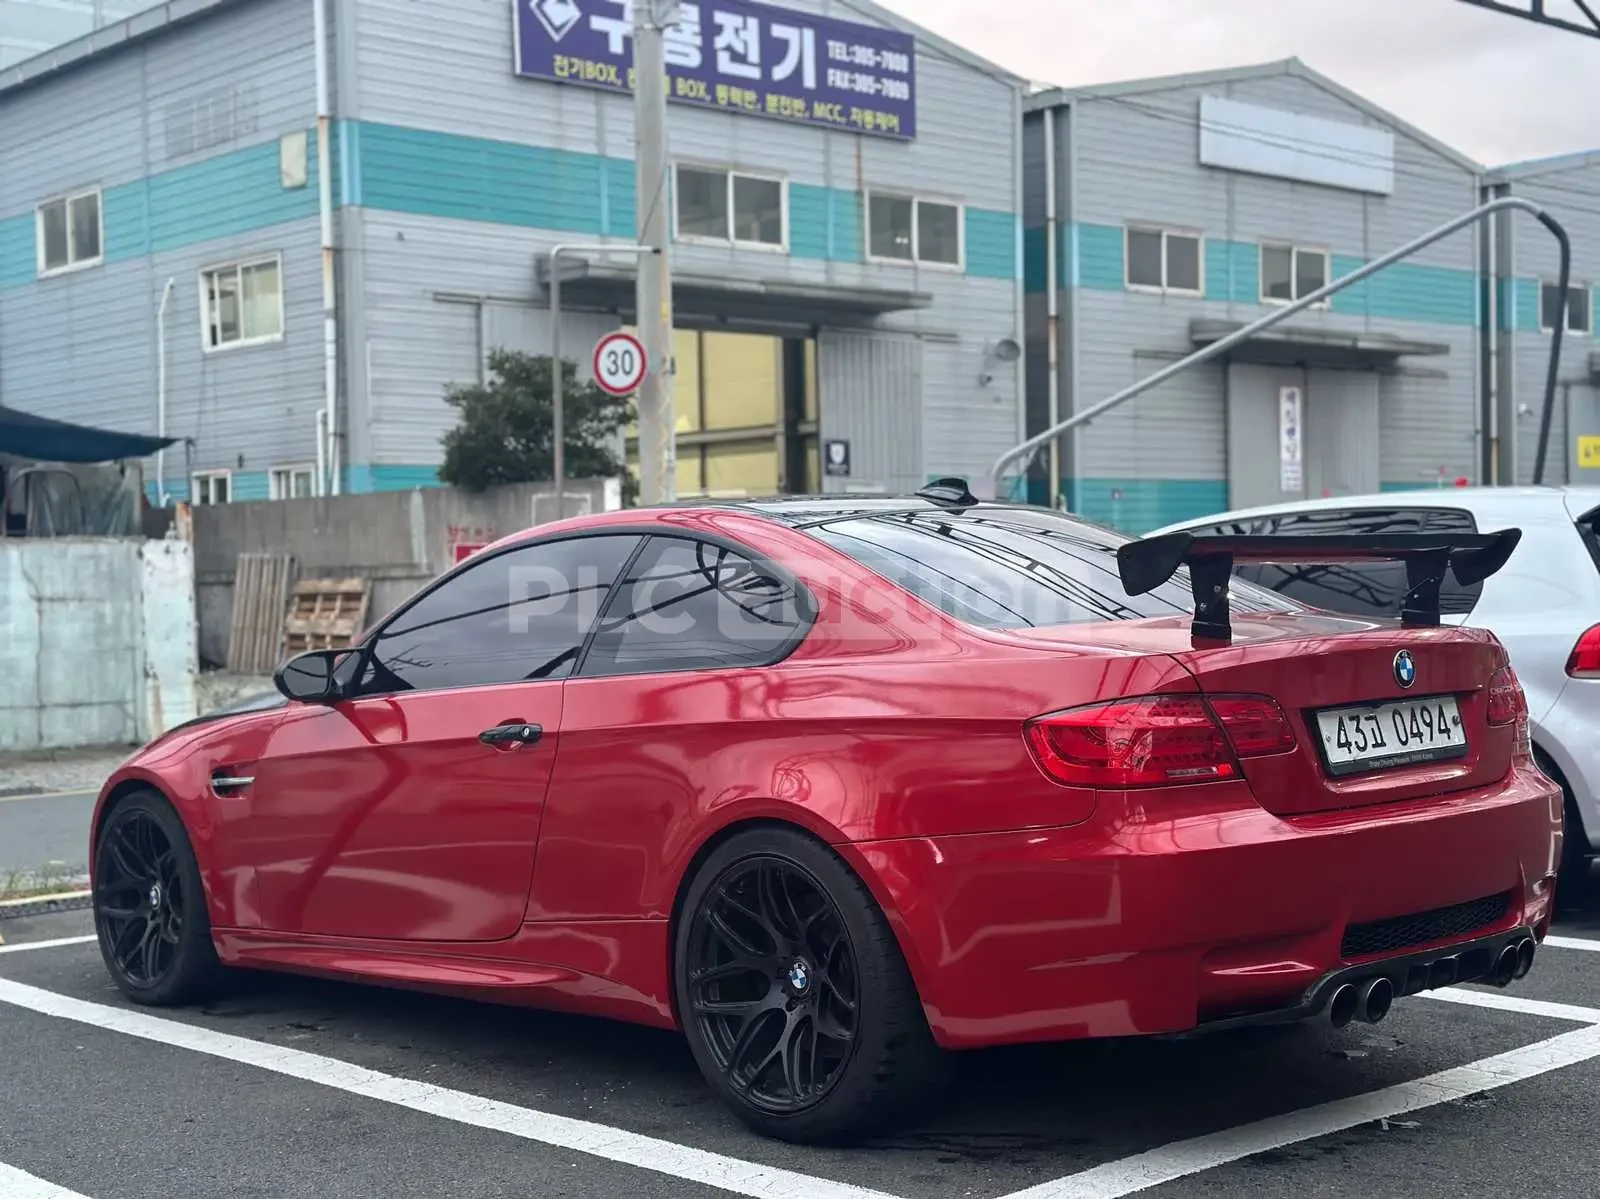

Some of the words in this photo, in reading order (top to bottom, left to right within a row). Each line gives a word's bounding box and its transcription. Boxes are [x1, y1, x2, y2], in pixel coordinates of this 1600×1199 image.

[607, 349, 634, 376] 30
[1337, 714, 1387, 754] 43고
[1392, 704, 1451, 745] 0494
